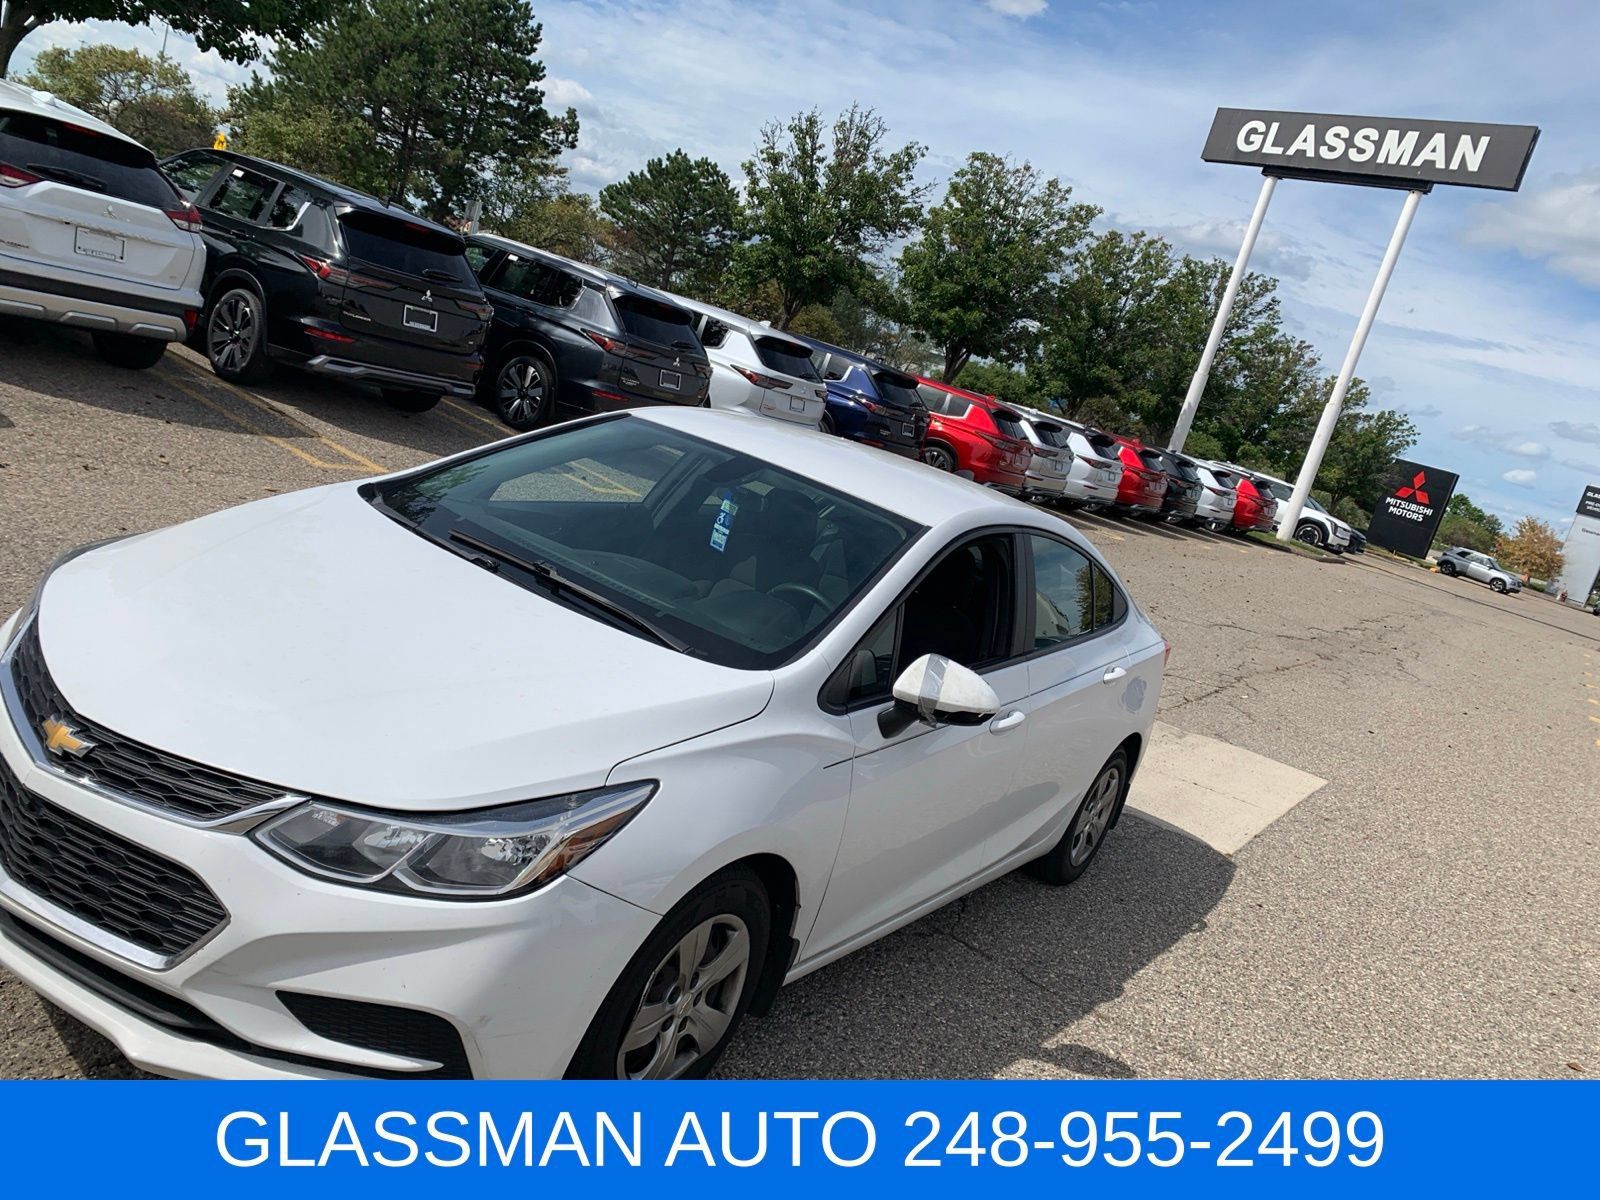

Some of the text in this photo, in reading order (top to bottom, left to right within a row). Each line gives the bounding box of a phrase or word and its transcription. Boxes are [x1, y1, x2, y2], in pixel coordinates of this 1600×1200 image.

[1236, 120, 1491, 172] GLASSMAN
[1385, 496, 1434, 516] MITSUBISHI
[1388, 505, 1424, 521] MOTORS
